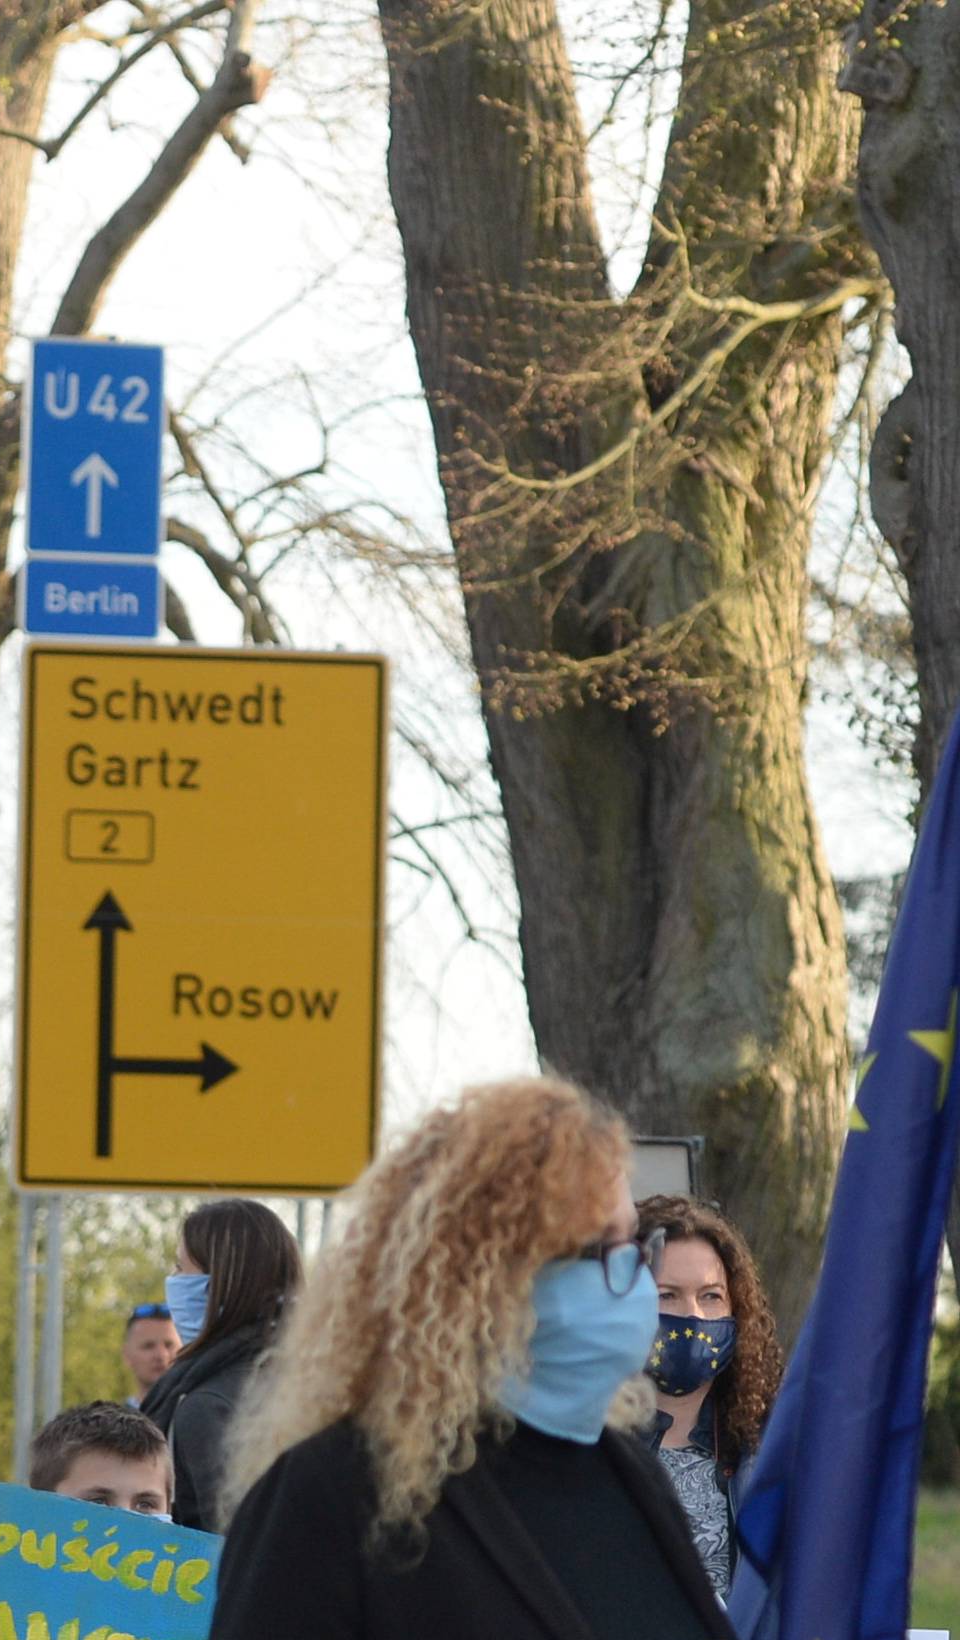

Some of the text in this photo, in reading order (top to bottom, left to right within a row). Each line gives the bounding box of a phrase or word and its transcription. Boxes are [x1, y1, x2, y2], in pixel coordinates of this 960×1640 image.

[44, 582, 139, 617] Berlin
[68, 676, 287, 727] Schwedt
[66, 743, 202, 790] Gartz
[99, 820, 122, 855] 2
[172, 973, 339, 1020] Rosow
